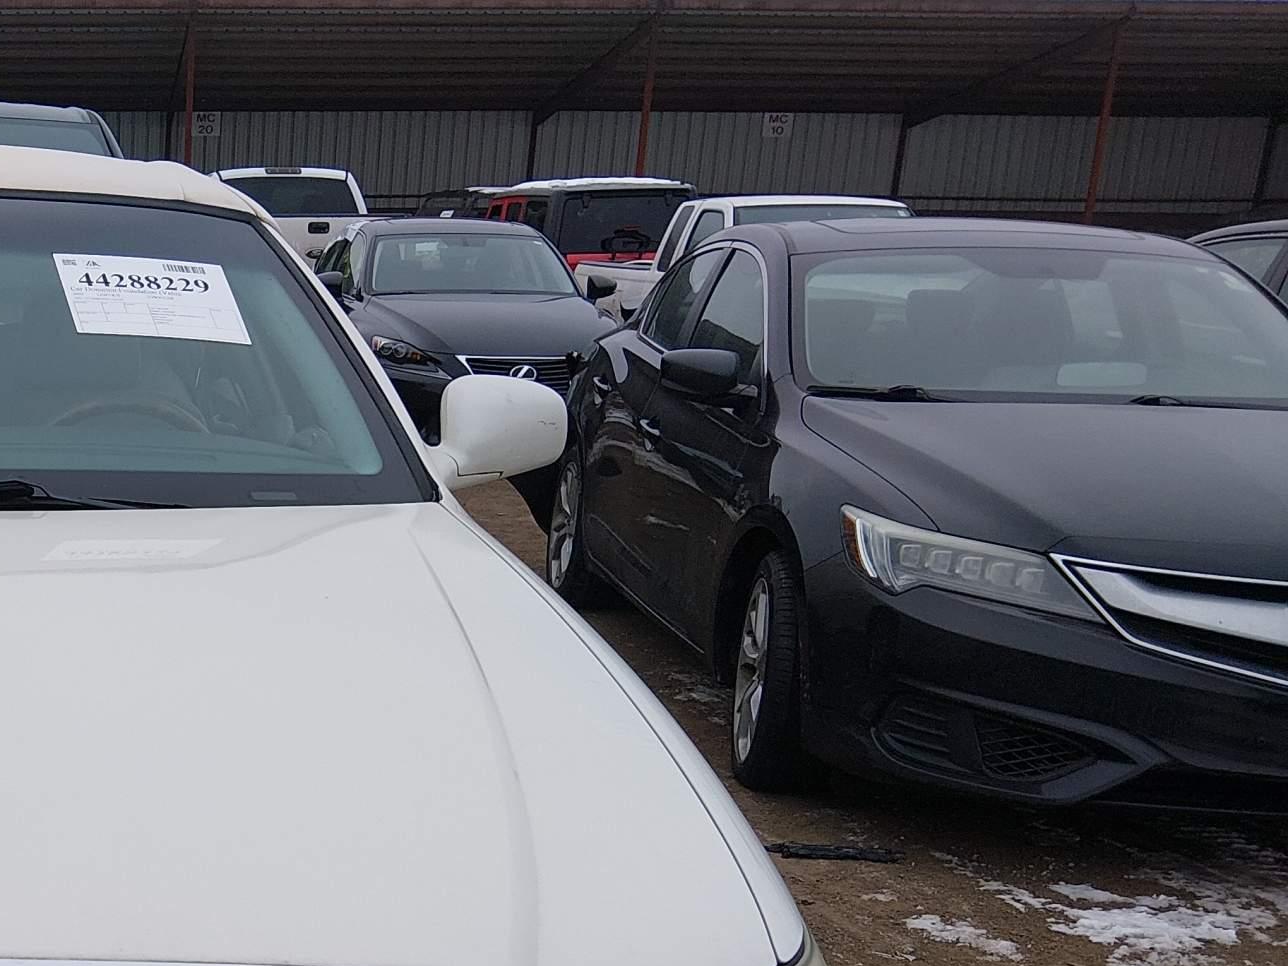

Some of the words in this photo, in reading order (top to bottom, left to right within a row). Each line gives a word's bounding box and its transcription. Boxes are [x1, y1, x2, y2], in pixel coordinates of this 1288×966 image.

[196, 113, 216, 123] MC
[768, 114, 789, 124] MC
[198, 125, 214, 135] 20
[772, 126, 784, 135] 10
[78, 271, 210, 294] 44288229
